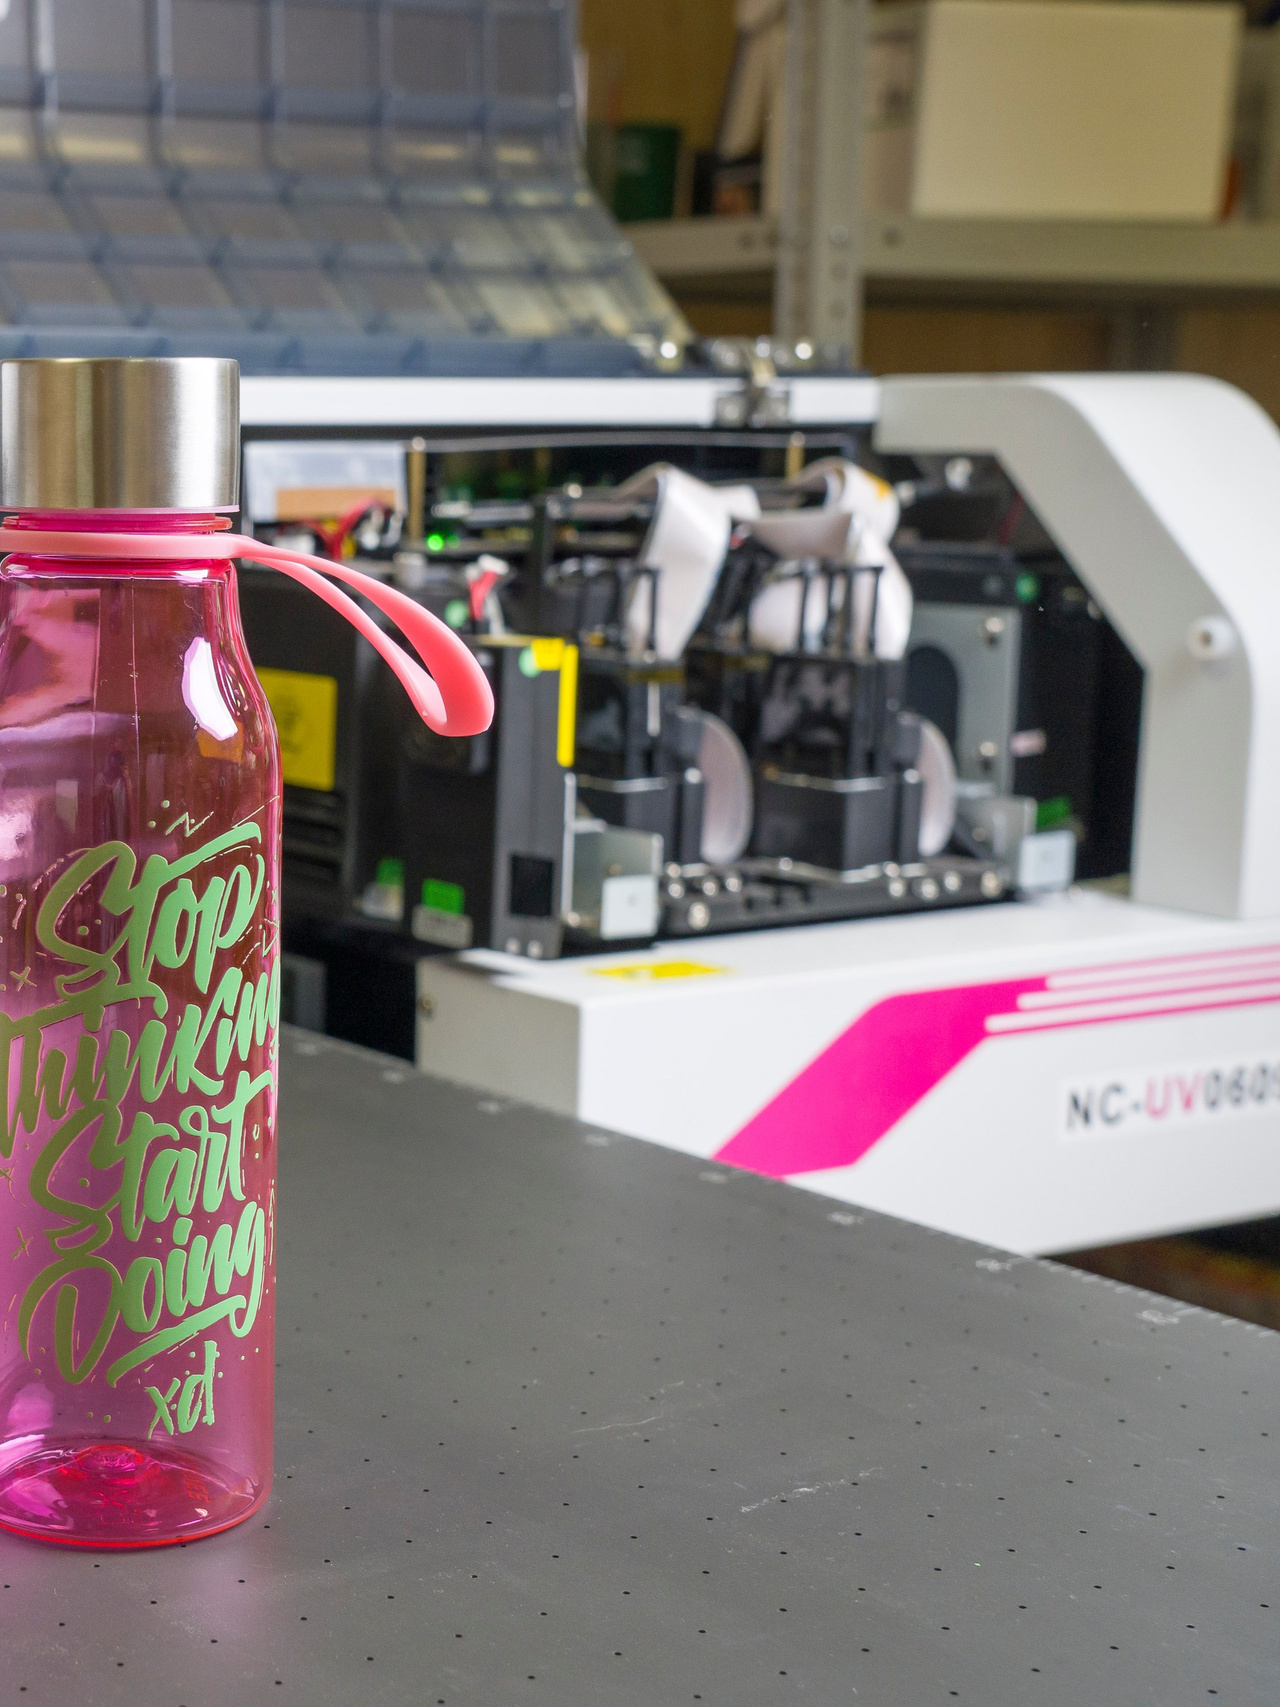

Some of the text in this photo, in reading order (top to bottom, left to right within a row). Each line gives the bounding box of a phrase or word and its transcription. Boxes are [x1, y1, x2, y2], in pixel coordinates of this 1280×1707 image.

[36, 822, 265, 1000] Stop
[29, 1070, 273, 1256] Start
[18, 1201, 264, 1388] Doing
